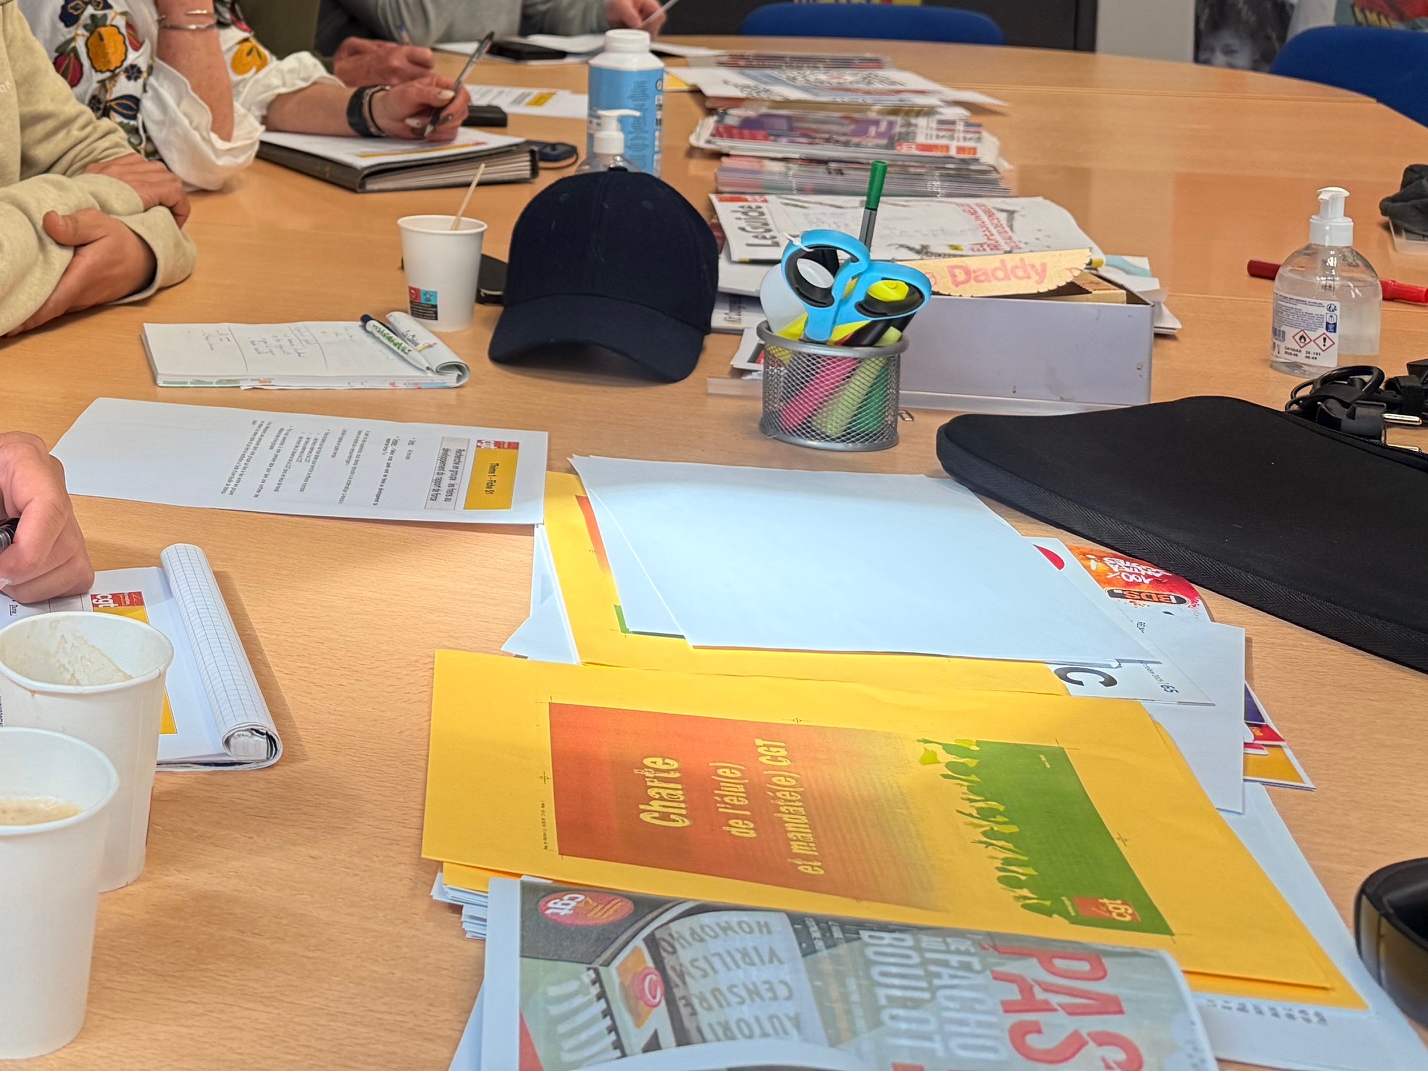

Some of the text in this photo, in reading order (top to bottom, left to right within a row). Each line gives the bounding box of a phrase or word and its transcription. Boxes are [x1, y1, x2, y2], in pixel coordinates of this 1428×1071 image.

[946, 257, 1048, 288] Daddy
[633, 757, 690, 828] Charte
[708, 762, 758, 838] de l'élu(e)
[754, 738, 826, 876] et mandaté(e) CGT
[545, 893, 586, 917] cgt
[1098, 898, 1133, 922] cgt
[677, 979, 794, 1018] CENSURE
[859, 930, 945, 1057] BOULOT
[924, 951, 1009, 1061] FACHO
[981, 943, 1144, 1071] PAS
